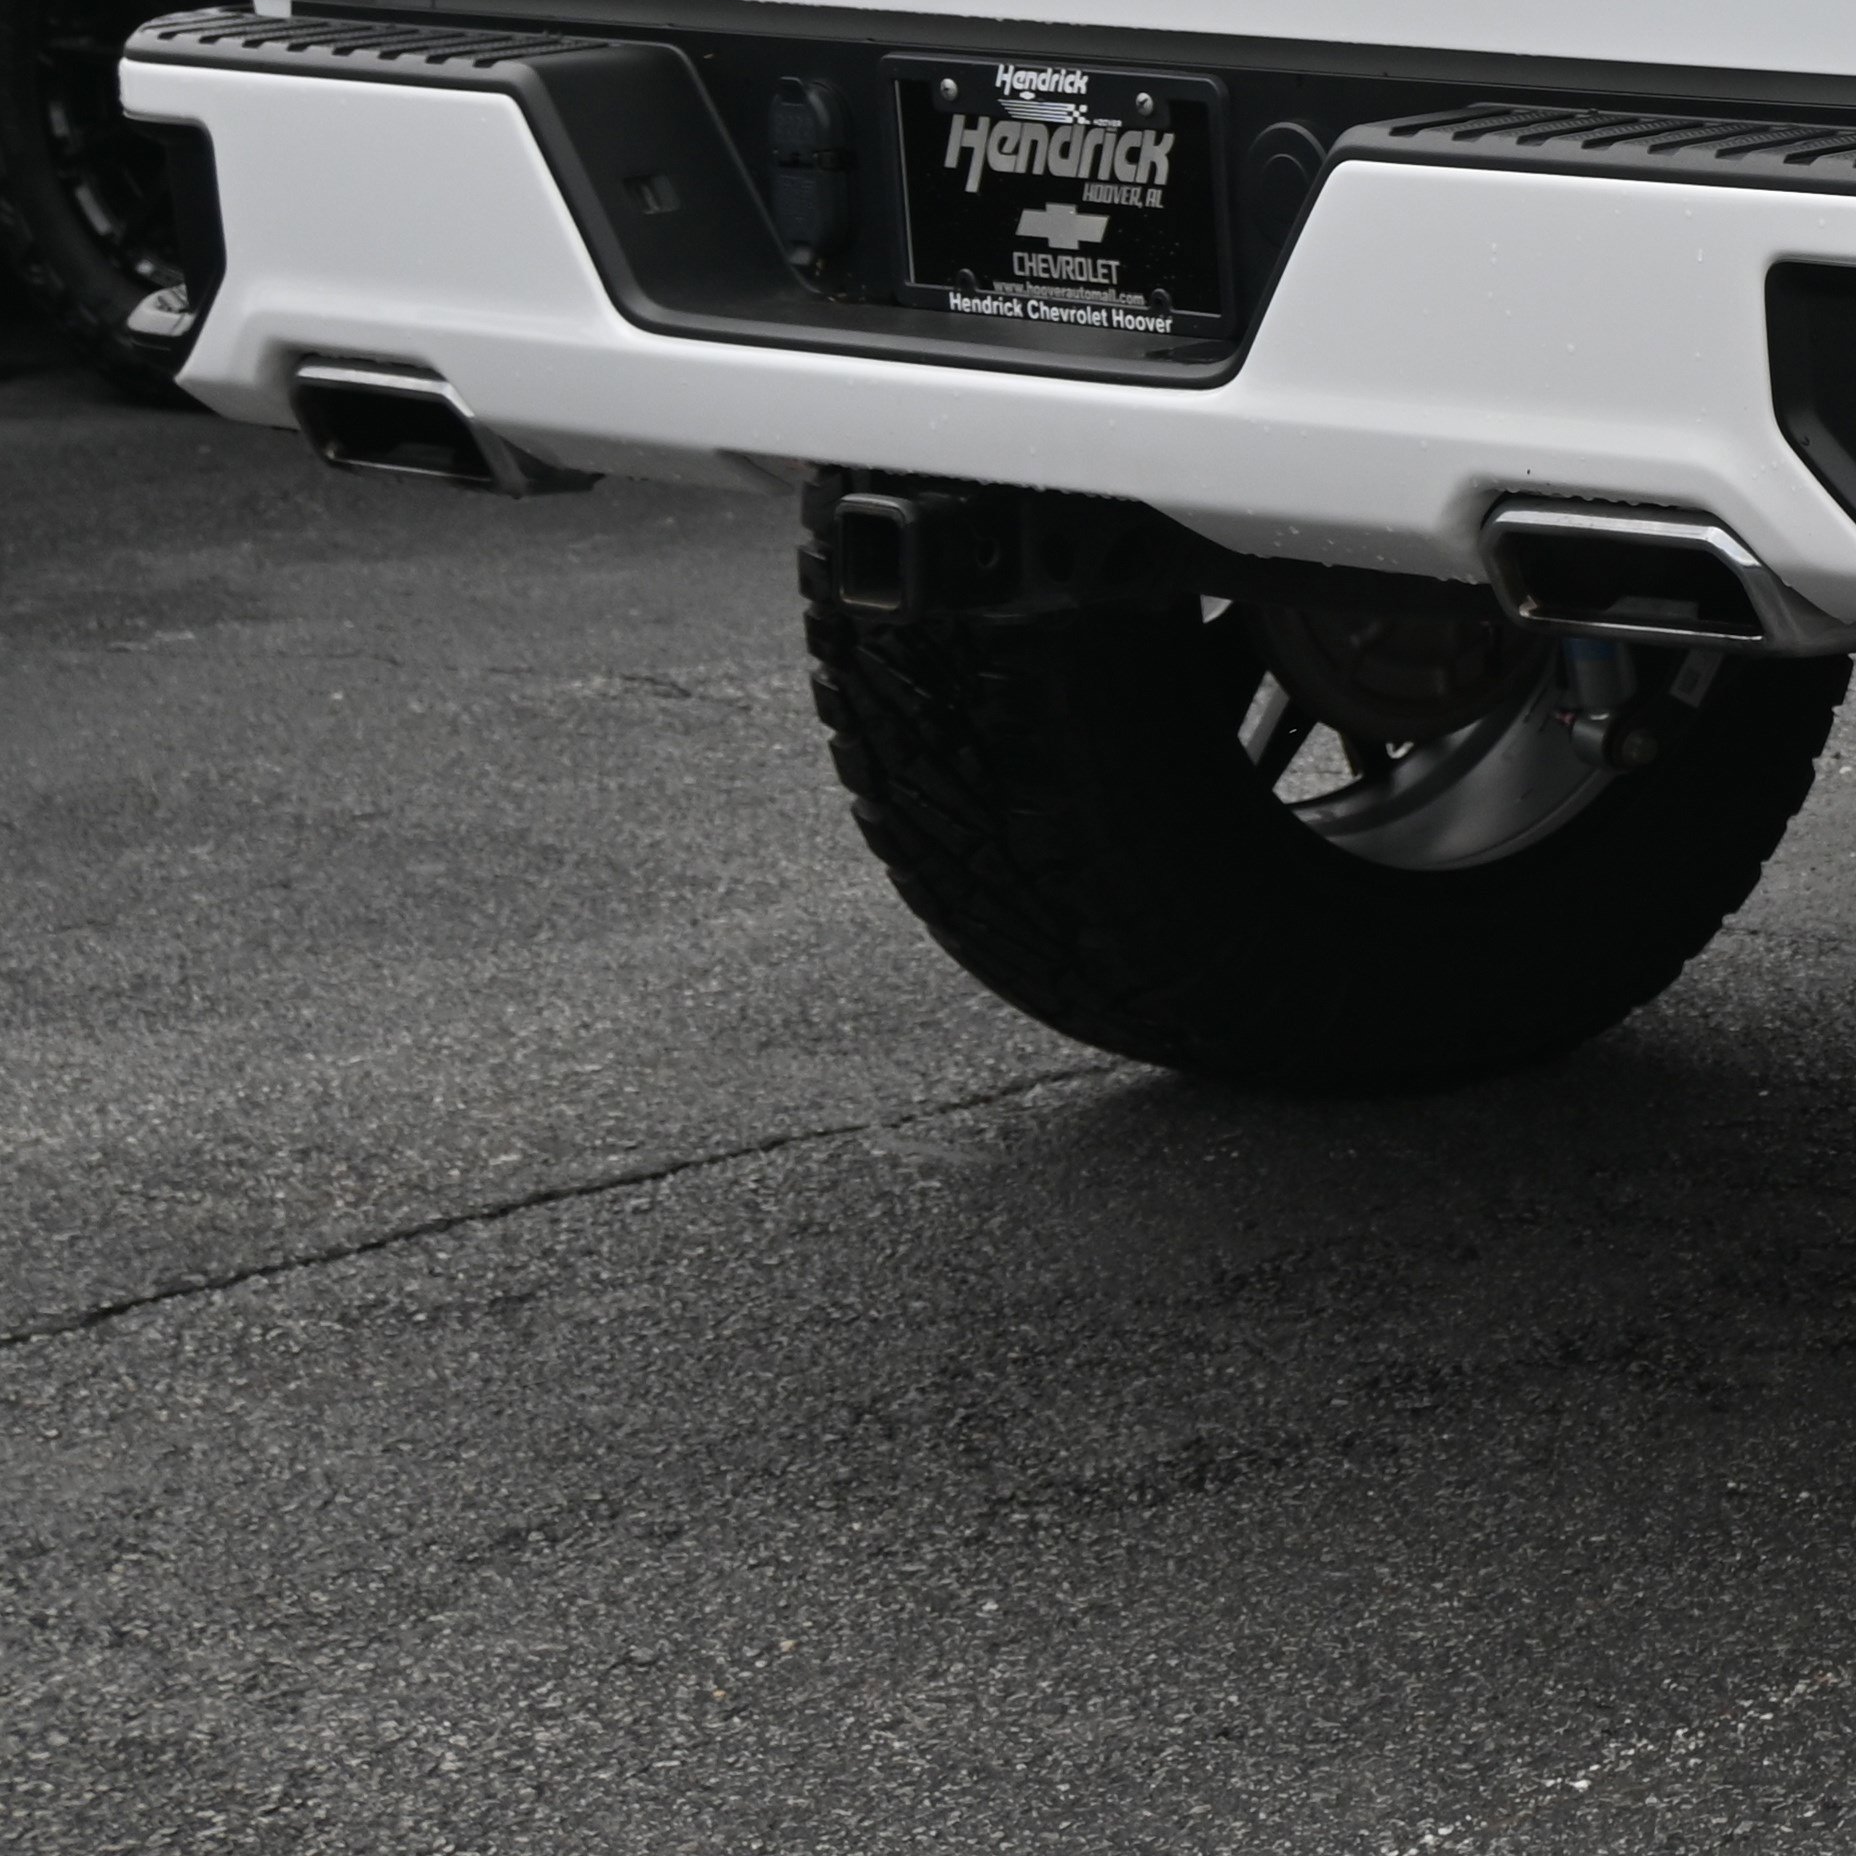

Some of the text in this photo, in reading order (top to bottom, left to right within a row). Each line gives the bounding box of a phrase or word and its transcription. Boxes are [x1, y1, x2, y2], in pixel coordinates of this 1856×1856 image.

[995, 64, 1089, 95] Hendrick
[944, 113, 1175, 193] Hendrick
[1145, 188, 1164, 208] AL
[1013, 251, 1120, 285] CHEVROLET
[949, 292, 1172, 333] Hendrick Chevrolet Hoover
